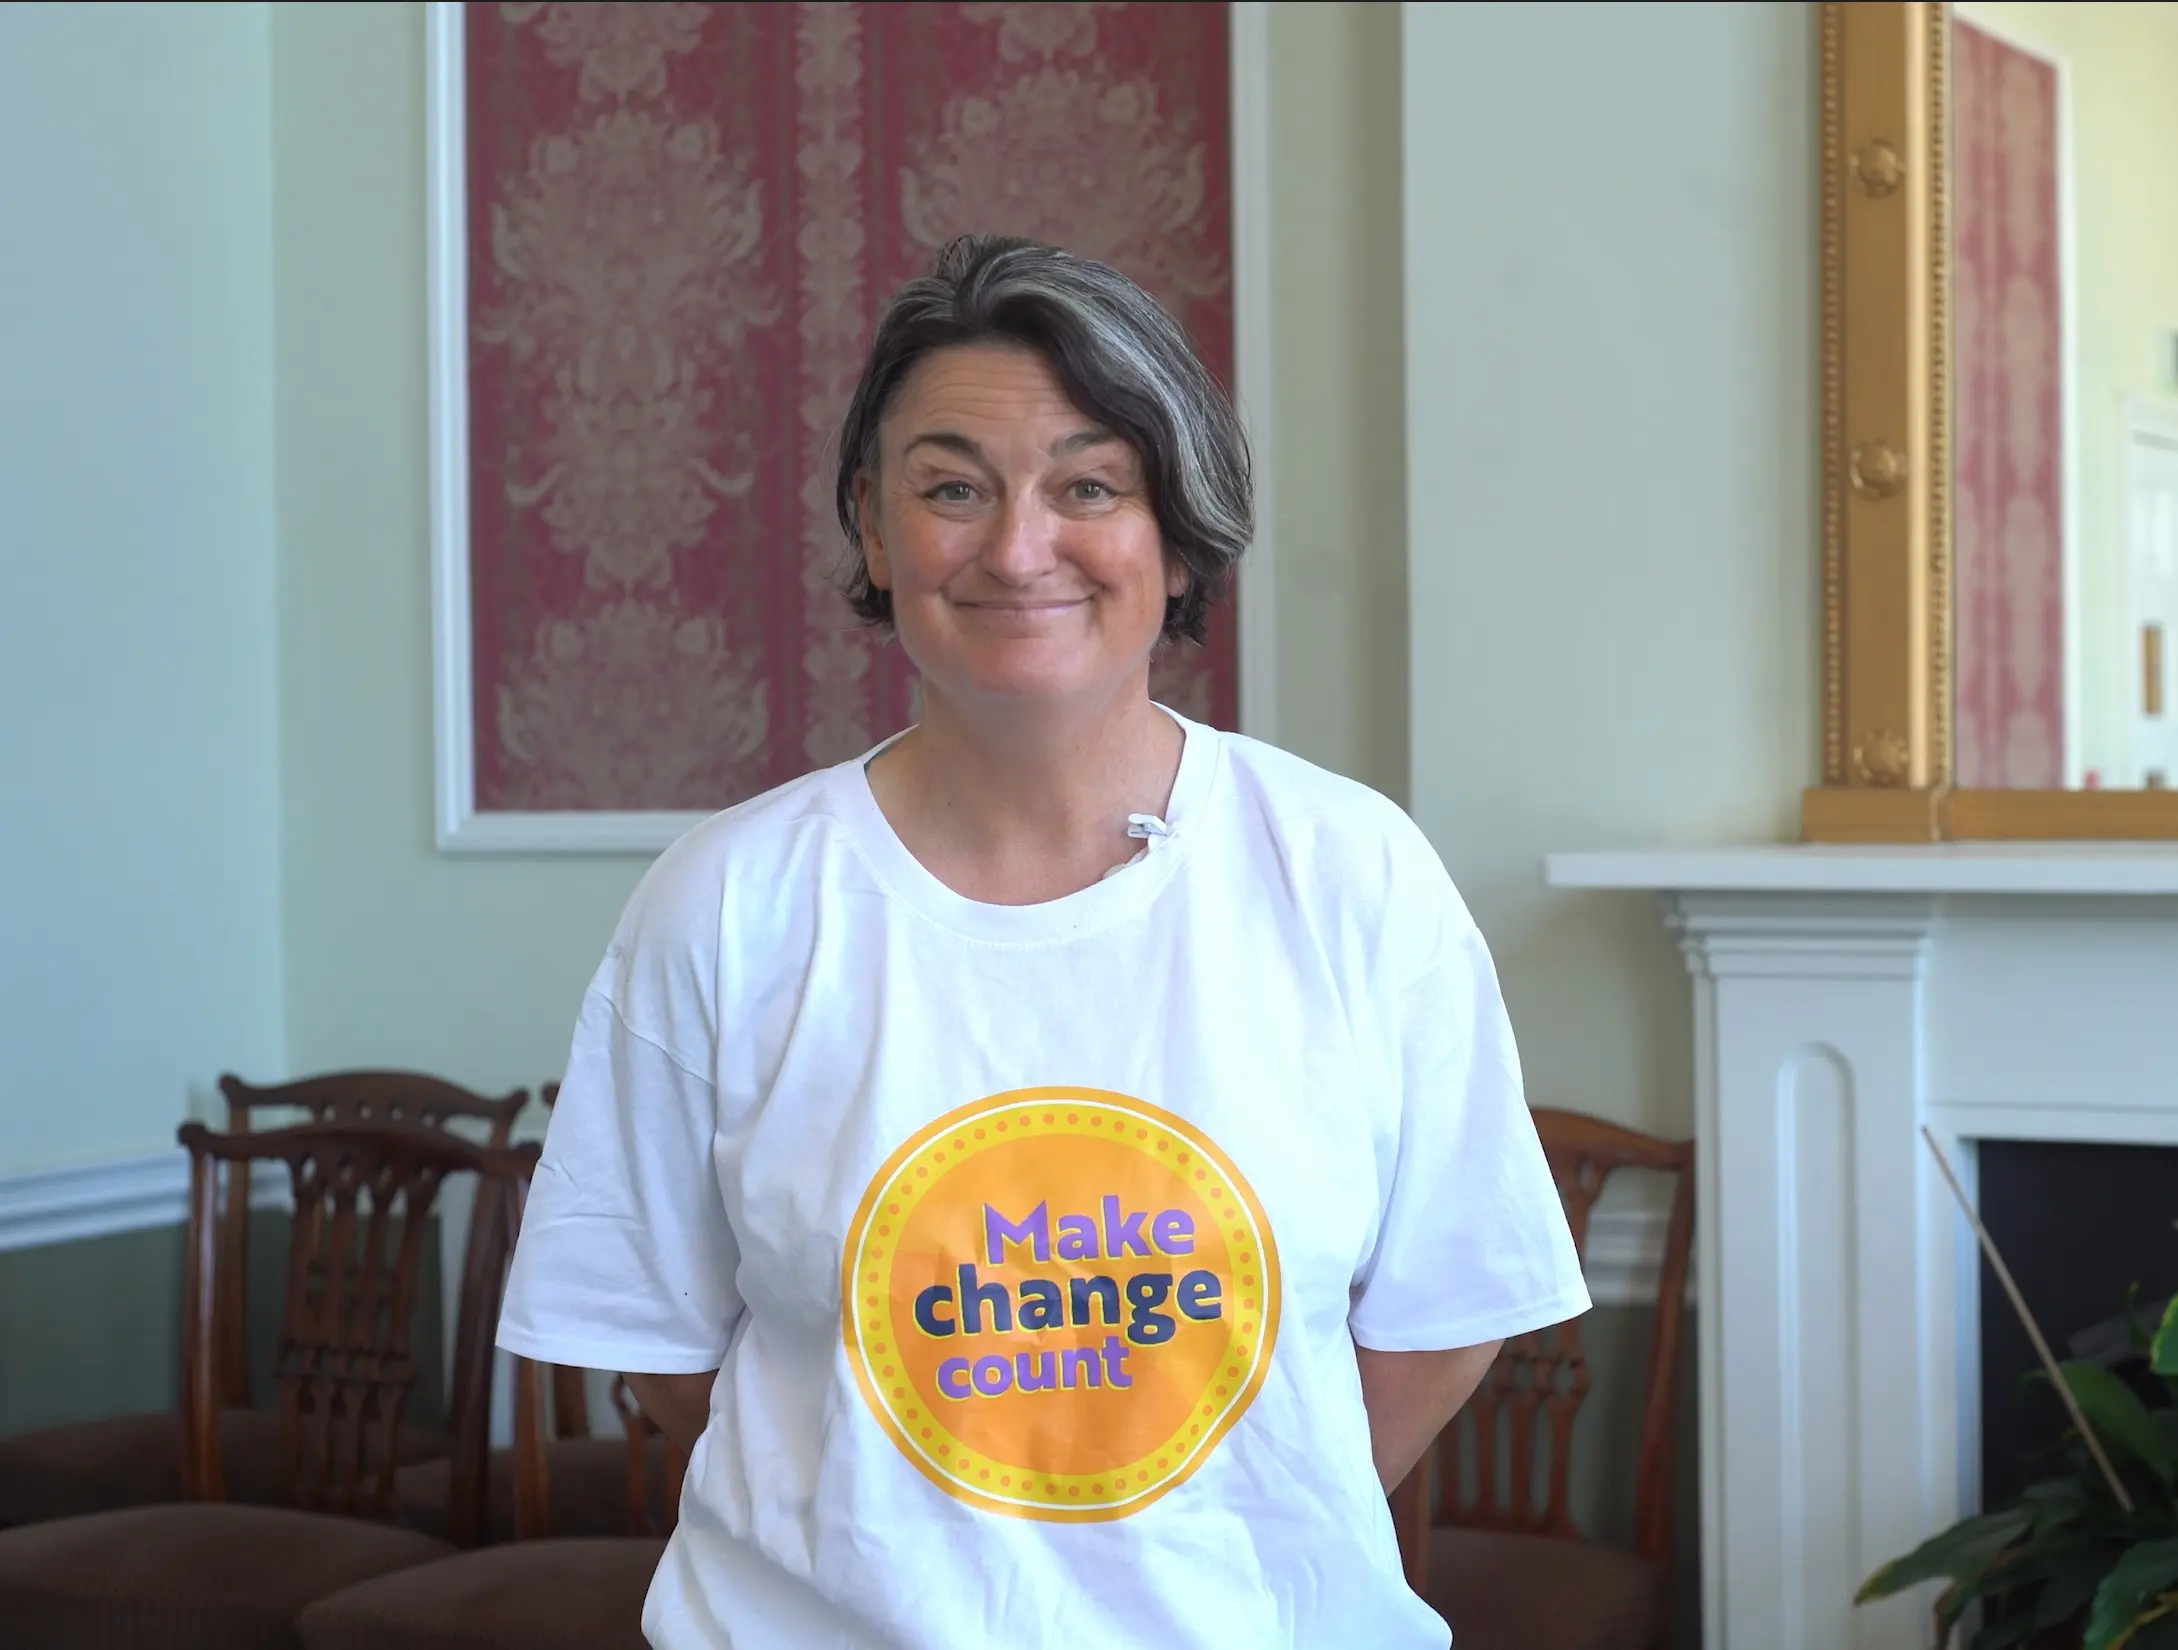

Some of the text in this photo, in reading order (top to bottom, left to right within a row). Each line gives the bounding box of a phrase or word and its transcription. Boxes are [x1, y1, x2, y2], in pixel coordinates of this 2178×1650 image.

[982, 1194, 1195, 1266] Make
[912, 1263, 1222, 1347] change
[936, 1336, 1133, 1401] count
